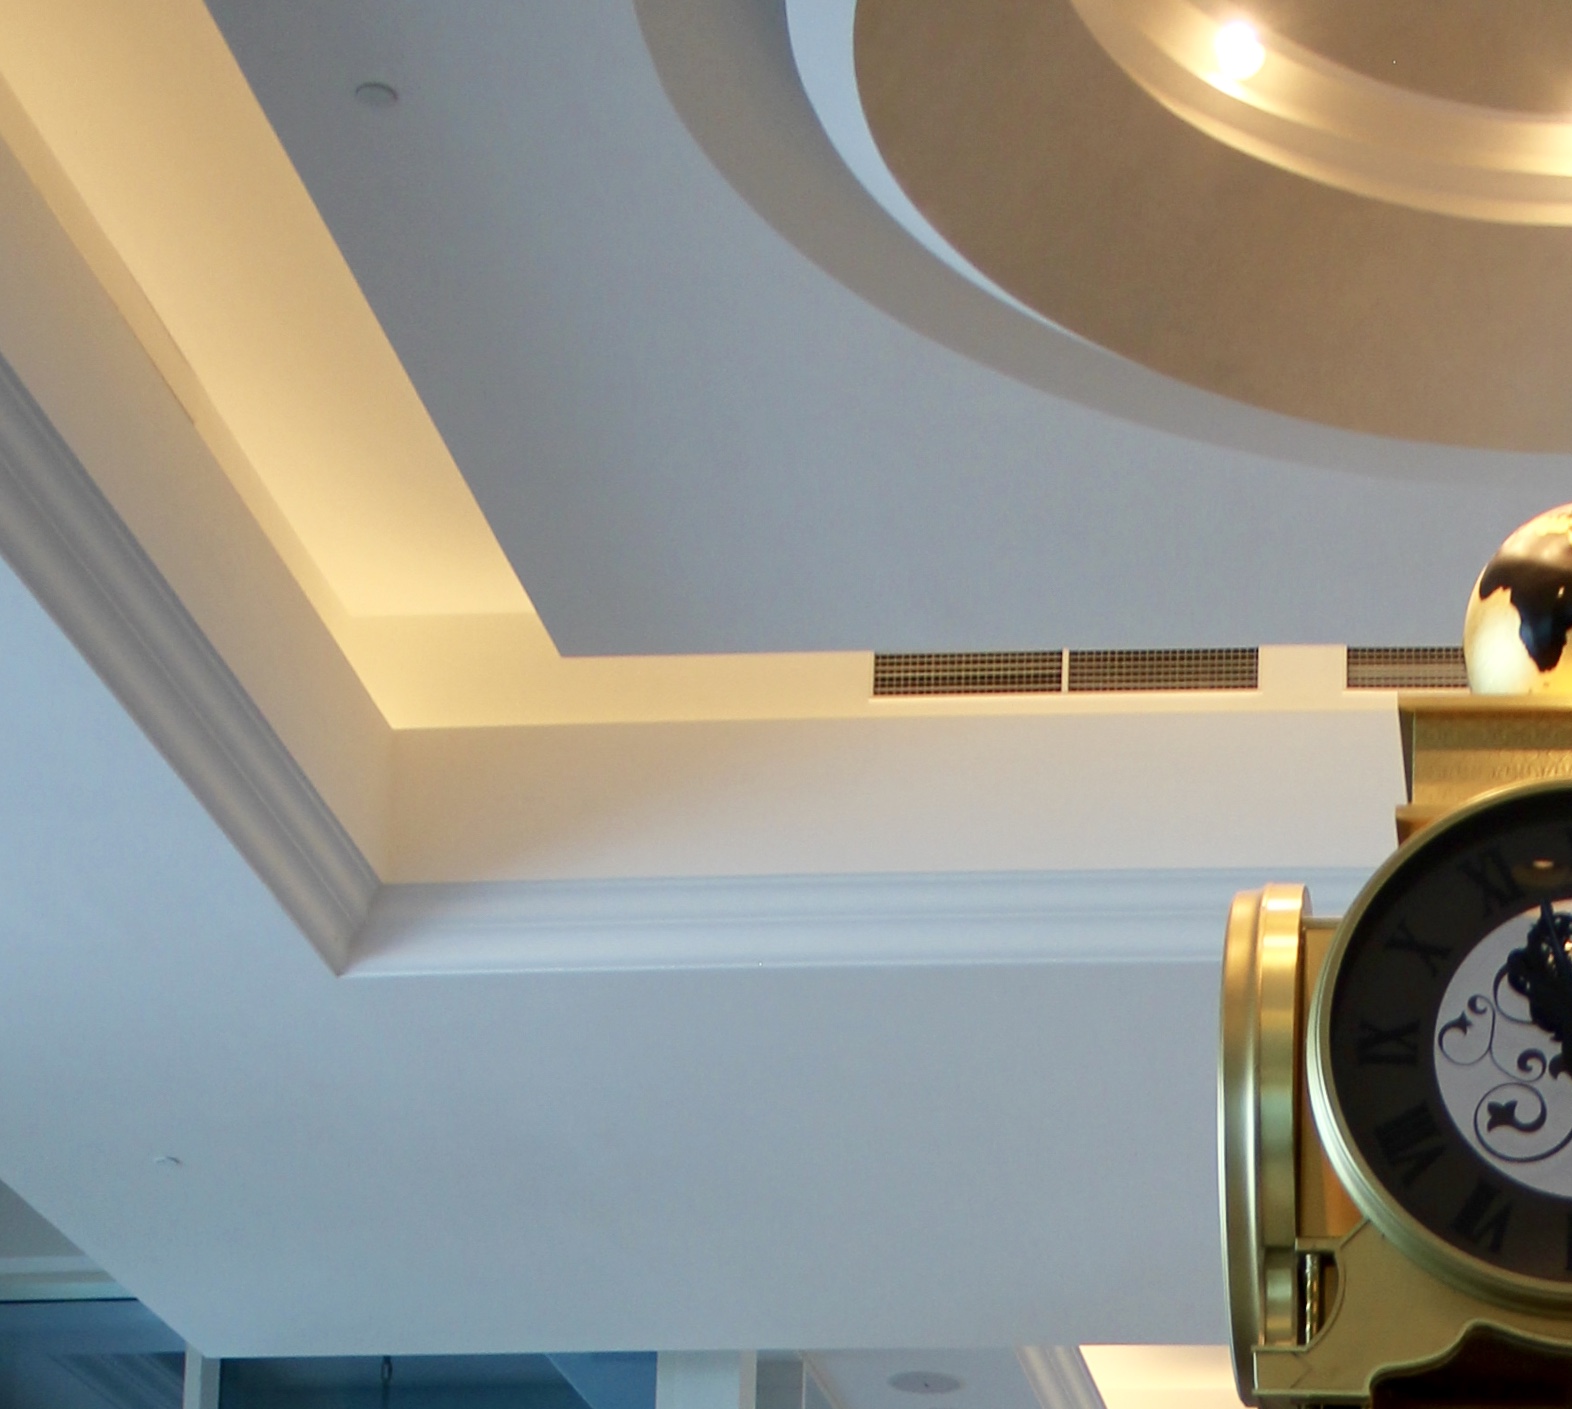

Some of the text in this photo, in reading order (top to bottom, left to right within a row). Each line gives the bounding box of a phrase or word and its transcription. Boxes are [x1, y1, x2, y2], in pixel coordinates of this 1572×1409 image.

[1385, 917, 1451, 977] X
[1357, 1020, 1421, 1066] IX
[1451, 1180, 1513, 1253] VII
